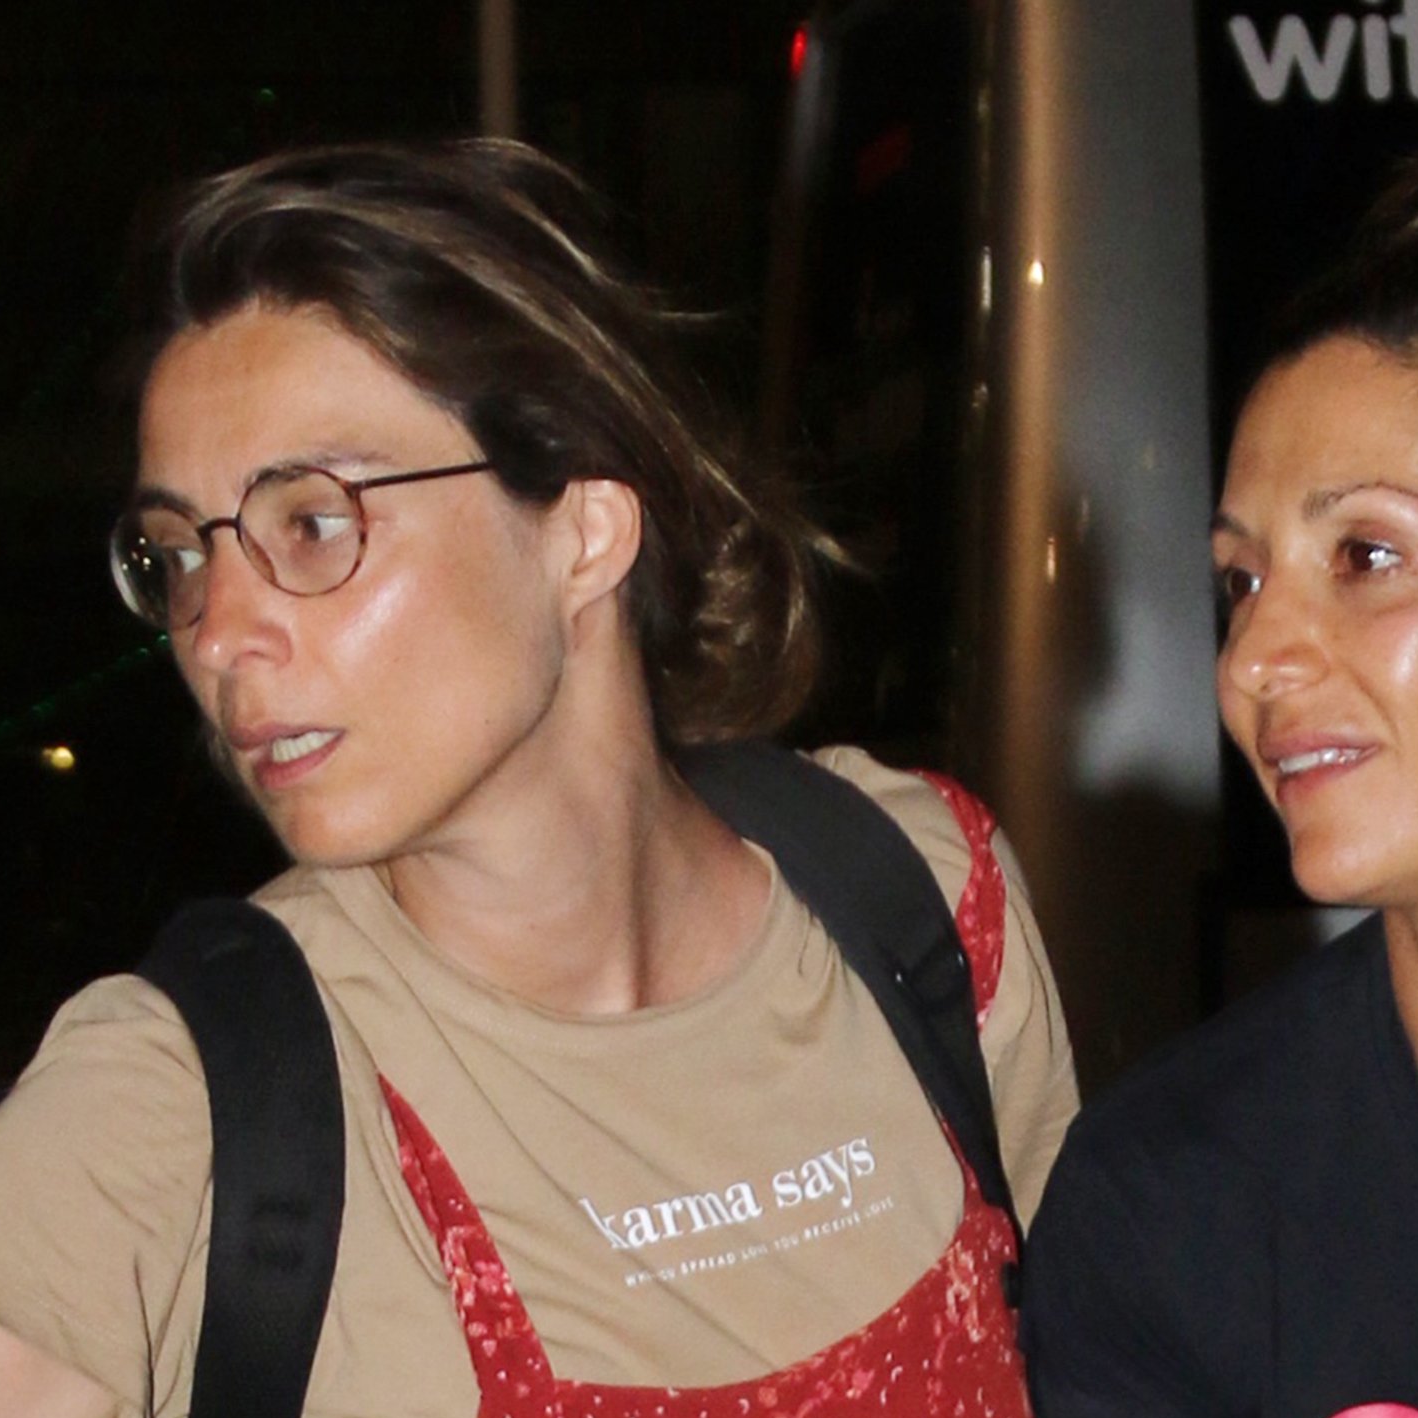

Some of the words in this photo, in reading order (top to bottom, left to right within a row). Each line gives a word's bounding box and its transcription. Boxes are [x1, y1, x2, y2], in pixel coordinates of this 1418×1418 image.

[579, 1181, 763, 1249] karma
[771, 1138, 876, 1207] says
[680, 1251, 736, 1275] SPREAD
